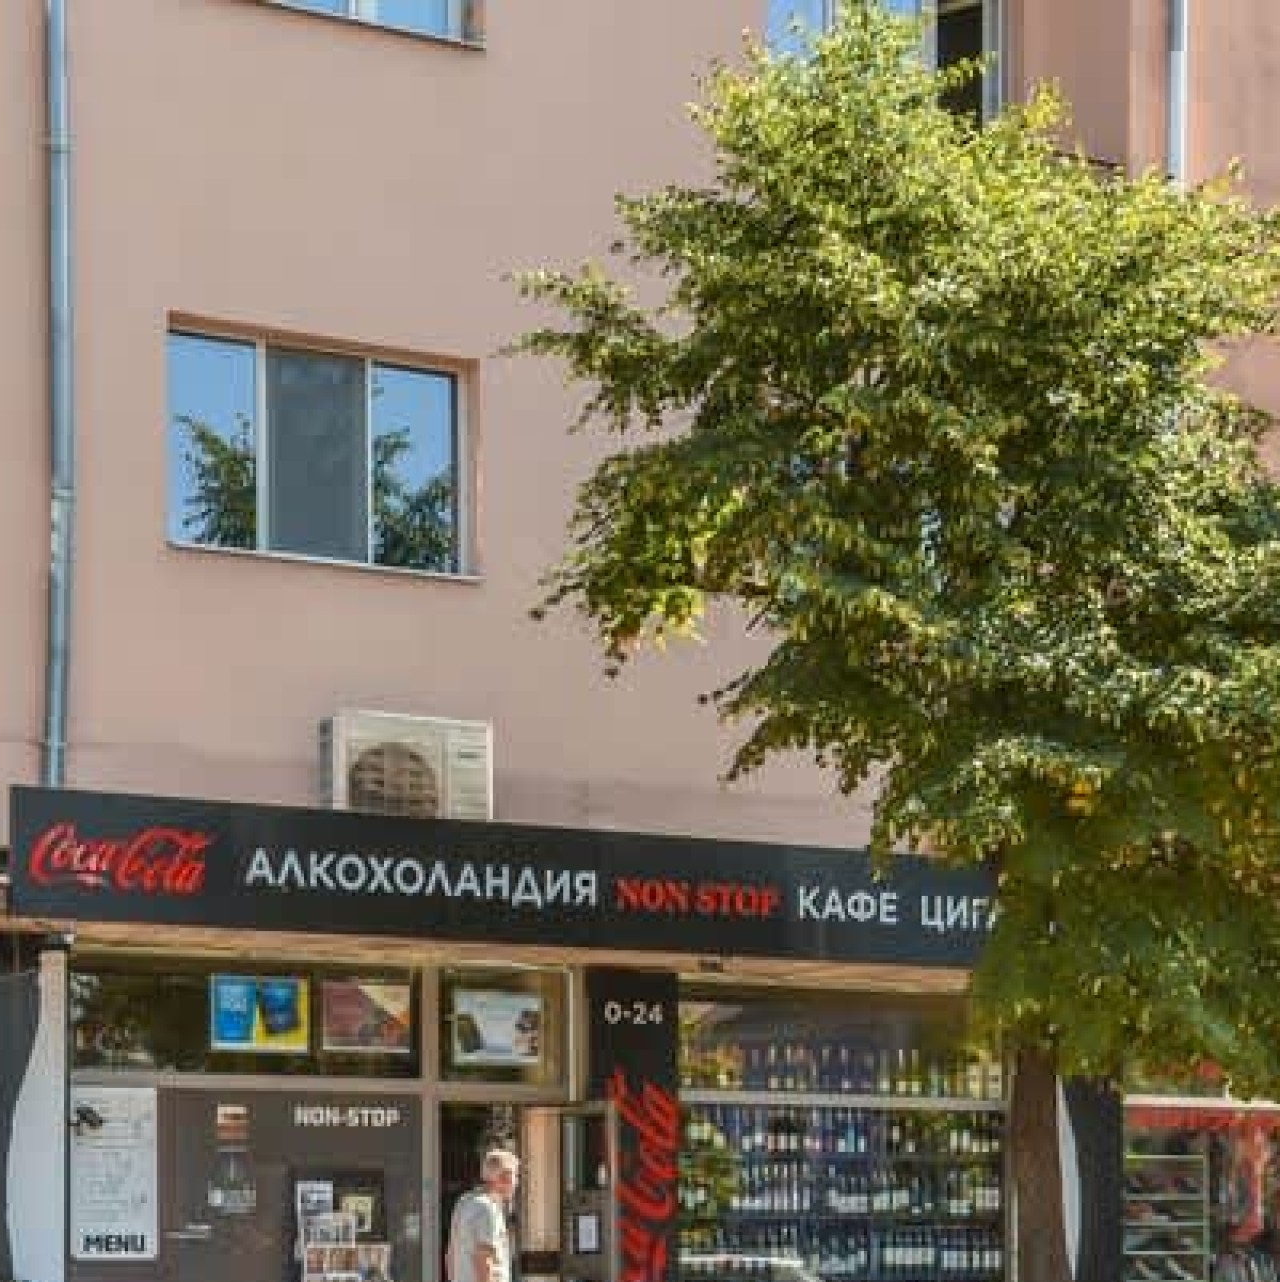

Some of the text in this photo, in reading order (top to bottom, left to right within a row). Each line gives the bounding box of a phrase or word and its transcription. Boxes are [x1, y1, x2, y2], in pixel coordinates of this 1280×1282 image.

[245, 847, 598, 909] АЛКОХОЛАНДИЯ
[613, 877, 783, 918] NON STOP
[798, 884, 898, 924] КАФЕ
[604, 1001, 663, 1025] 0-24
[293, 1105, 402, 1127] NON-STOP
[82, 1233, 146, 1253] MENU
